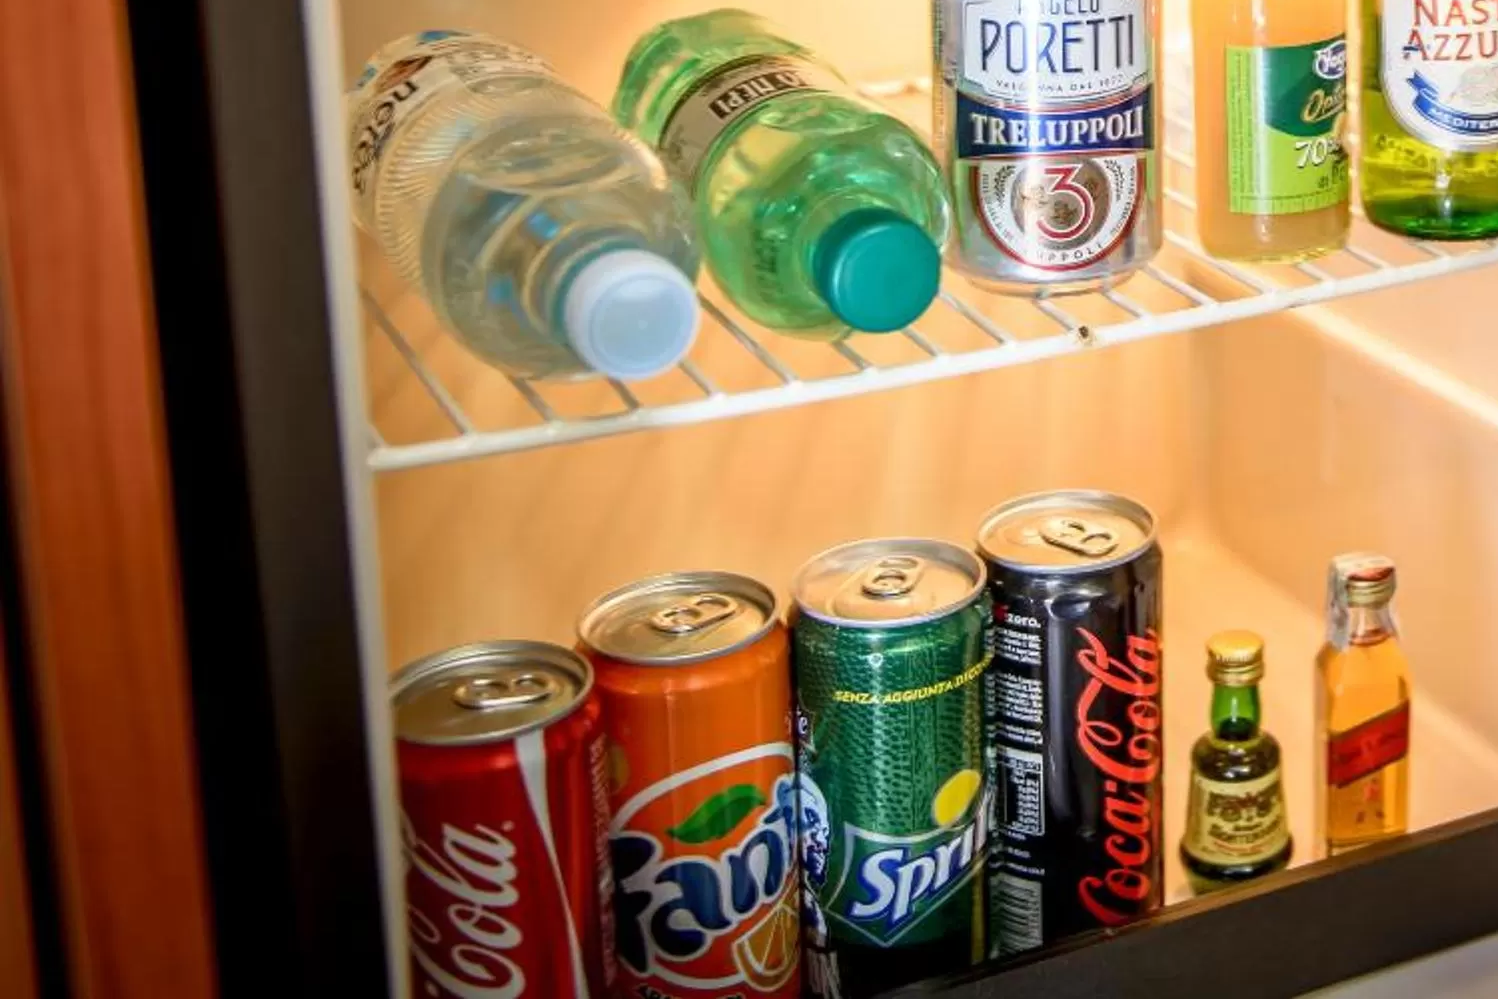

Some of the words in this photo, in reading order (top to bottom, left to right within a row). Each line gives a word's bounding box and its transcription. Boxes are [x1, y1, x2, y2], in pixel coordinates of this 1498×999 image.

[980, 14, 1134, 74] PORETTI
[1035, 164, 1095, 241] 3
[834, 690, 881, 704] SENZA
[883, 681, 953, 704] AGGIUNTA
[1076, 626, 1162, 926] Coca-Cola
